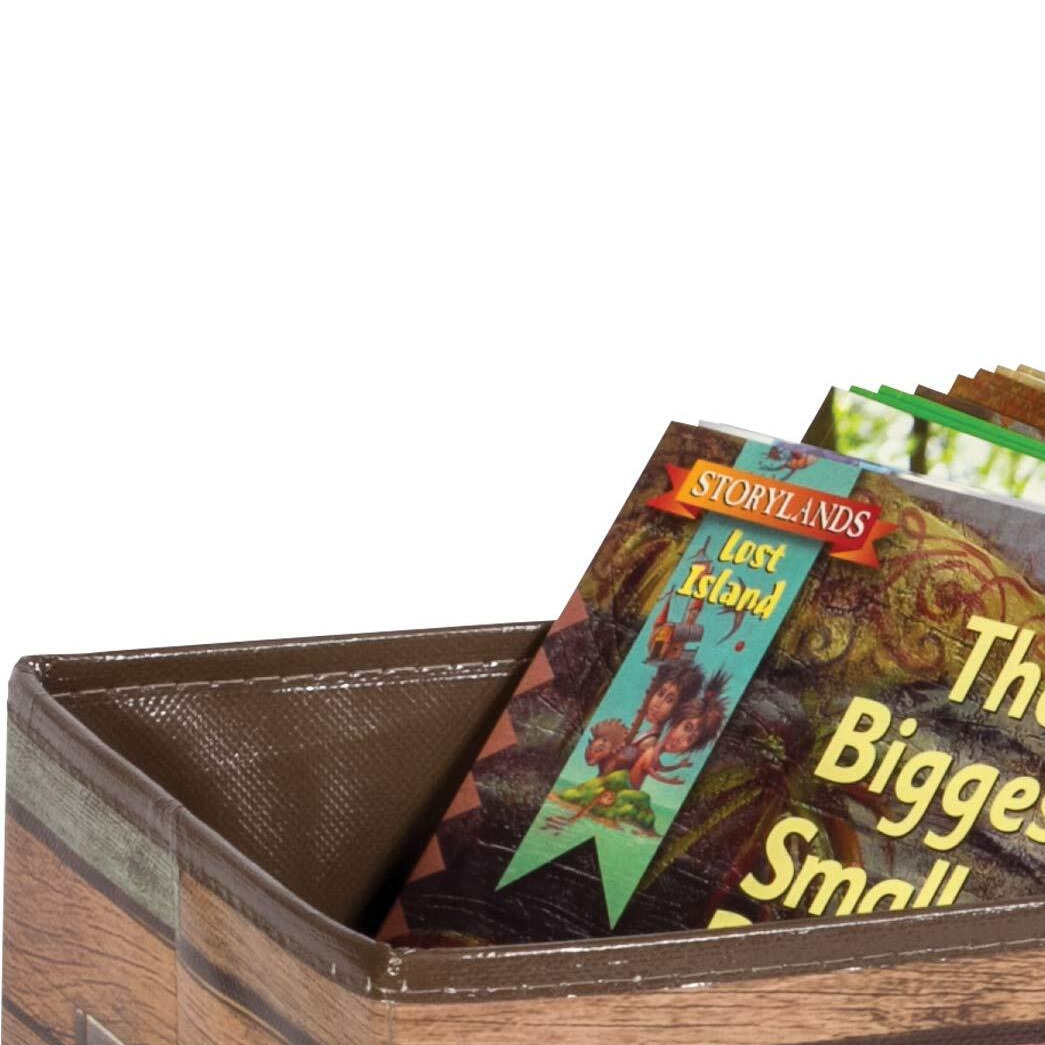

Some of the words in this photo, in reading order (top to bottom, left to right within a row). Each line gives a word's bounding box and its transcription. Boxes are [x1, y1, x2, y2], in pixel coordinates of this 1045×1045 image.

[691, 471, 870, 538] STORYLANDS
[718, 530, 787, 573] Lost
[676, 565, 786, 619] Island
